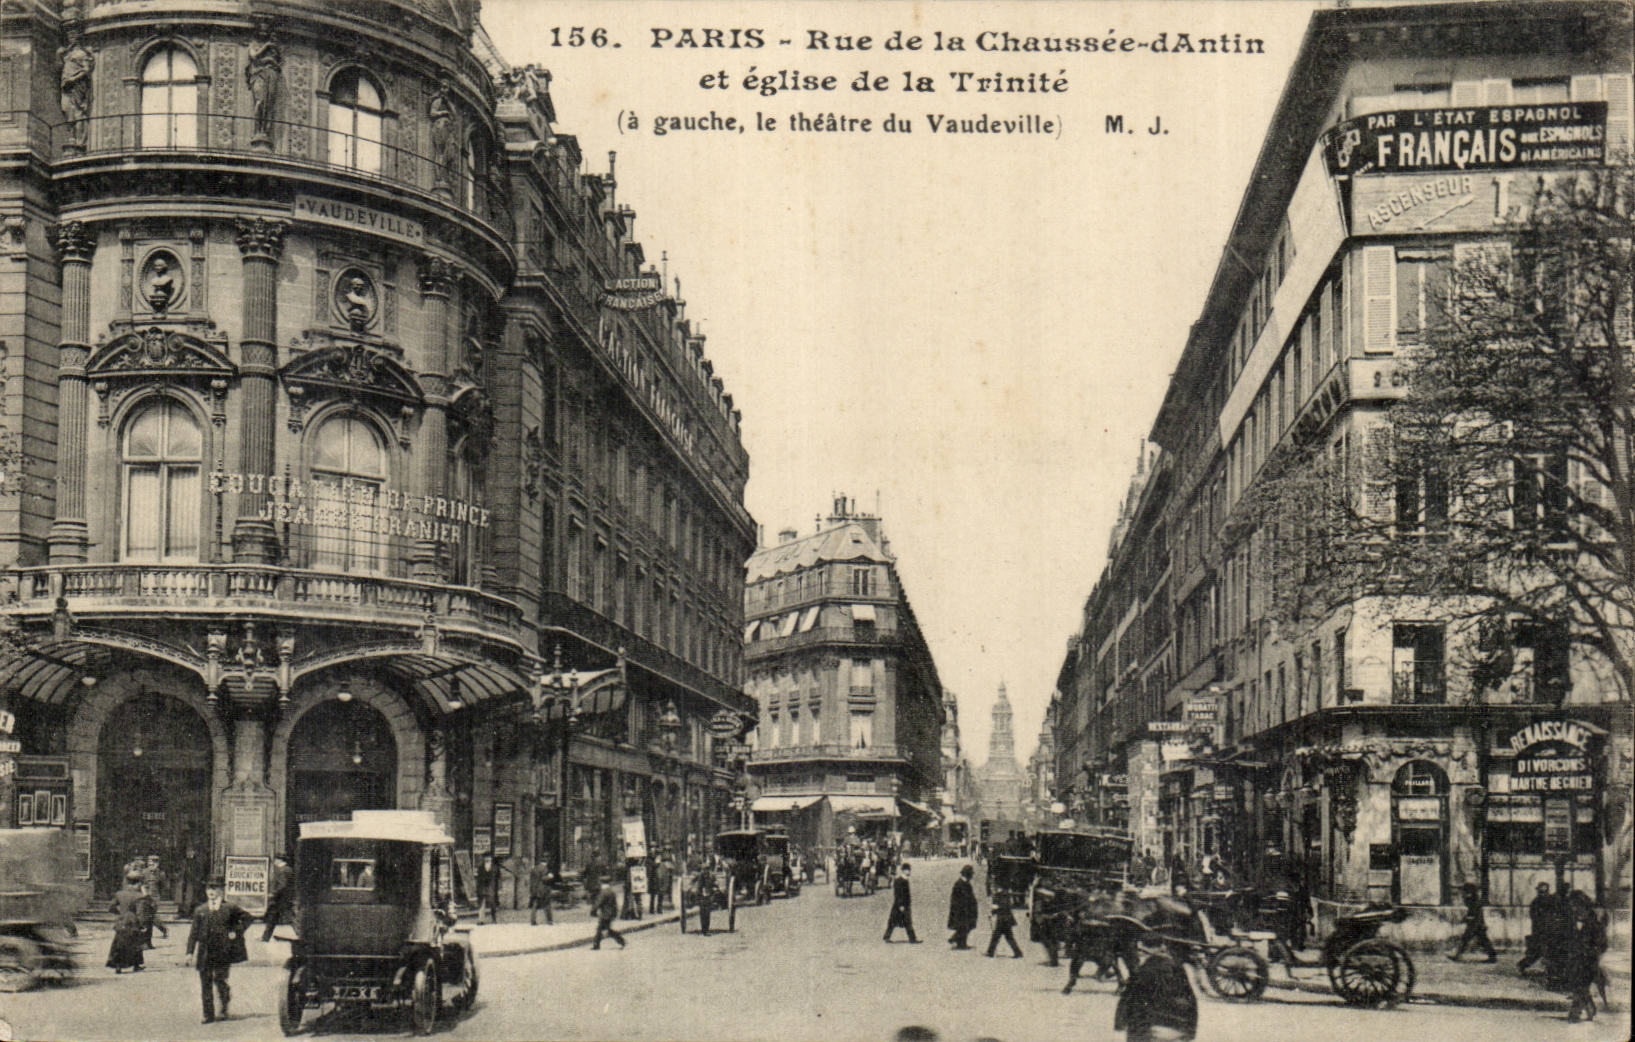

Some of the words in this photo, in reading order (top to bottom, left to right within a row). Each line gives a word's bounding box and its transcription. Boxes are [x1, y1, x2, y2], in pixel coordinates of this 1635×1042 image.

[1367, 114, 1396, 130] PAR
[1489, 106, 1582, 123] ESPAGNOL
[1539, 124, 1603, 143] ESPAGNOLS
[1377, 128, 1517, 170] FRANÇAIS
[306, 201, 415, 239] VAUDEVILLE
[1367, 176, 1473, 232] ASCENSEUR
[423, 495, 492, 529] PRINCE
[1510, 720, 1593, 753] RENAISSANCE
[228, 881, 265, 892] PRINCE
